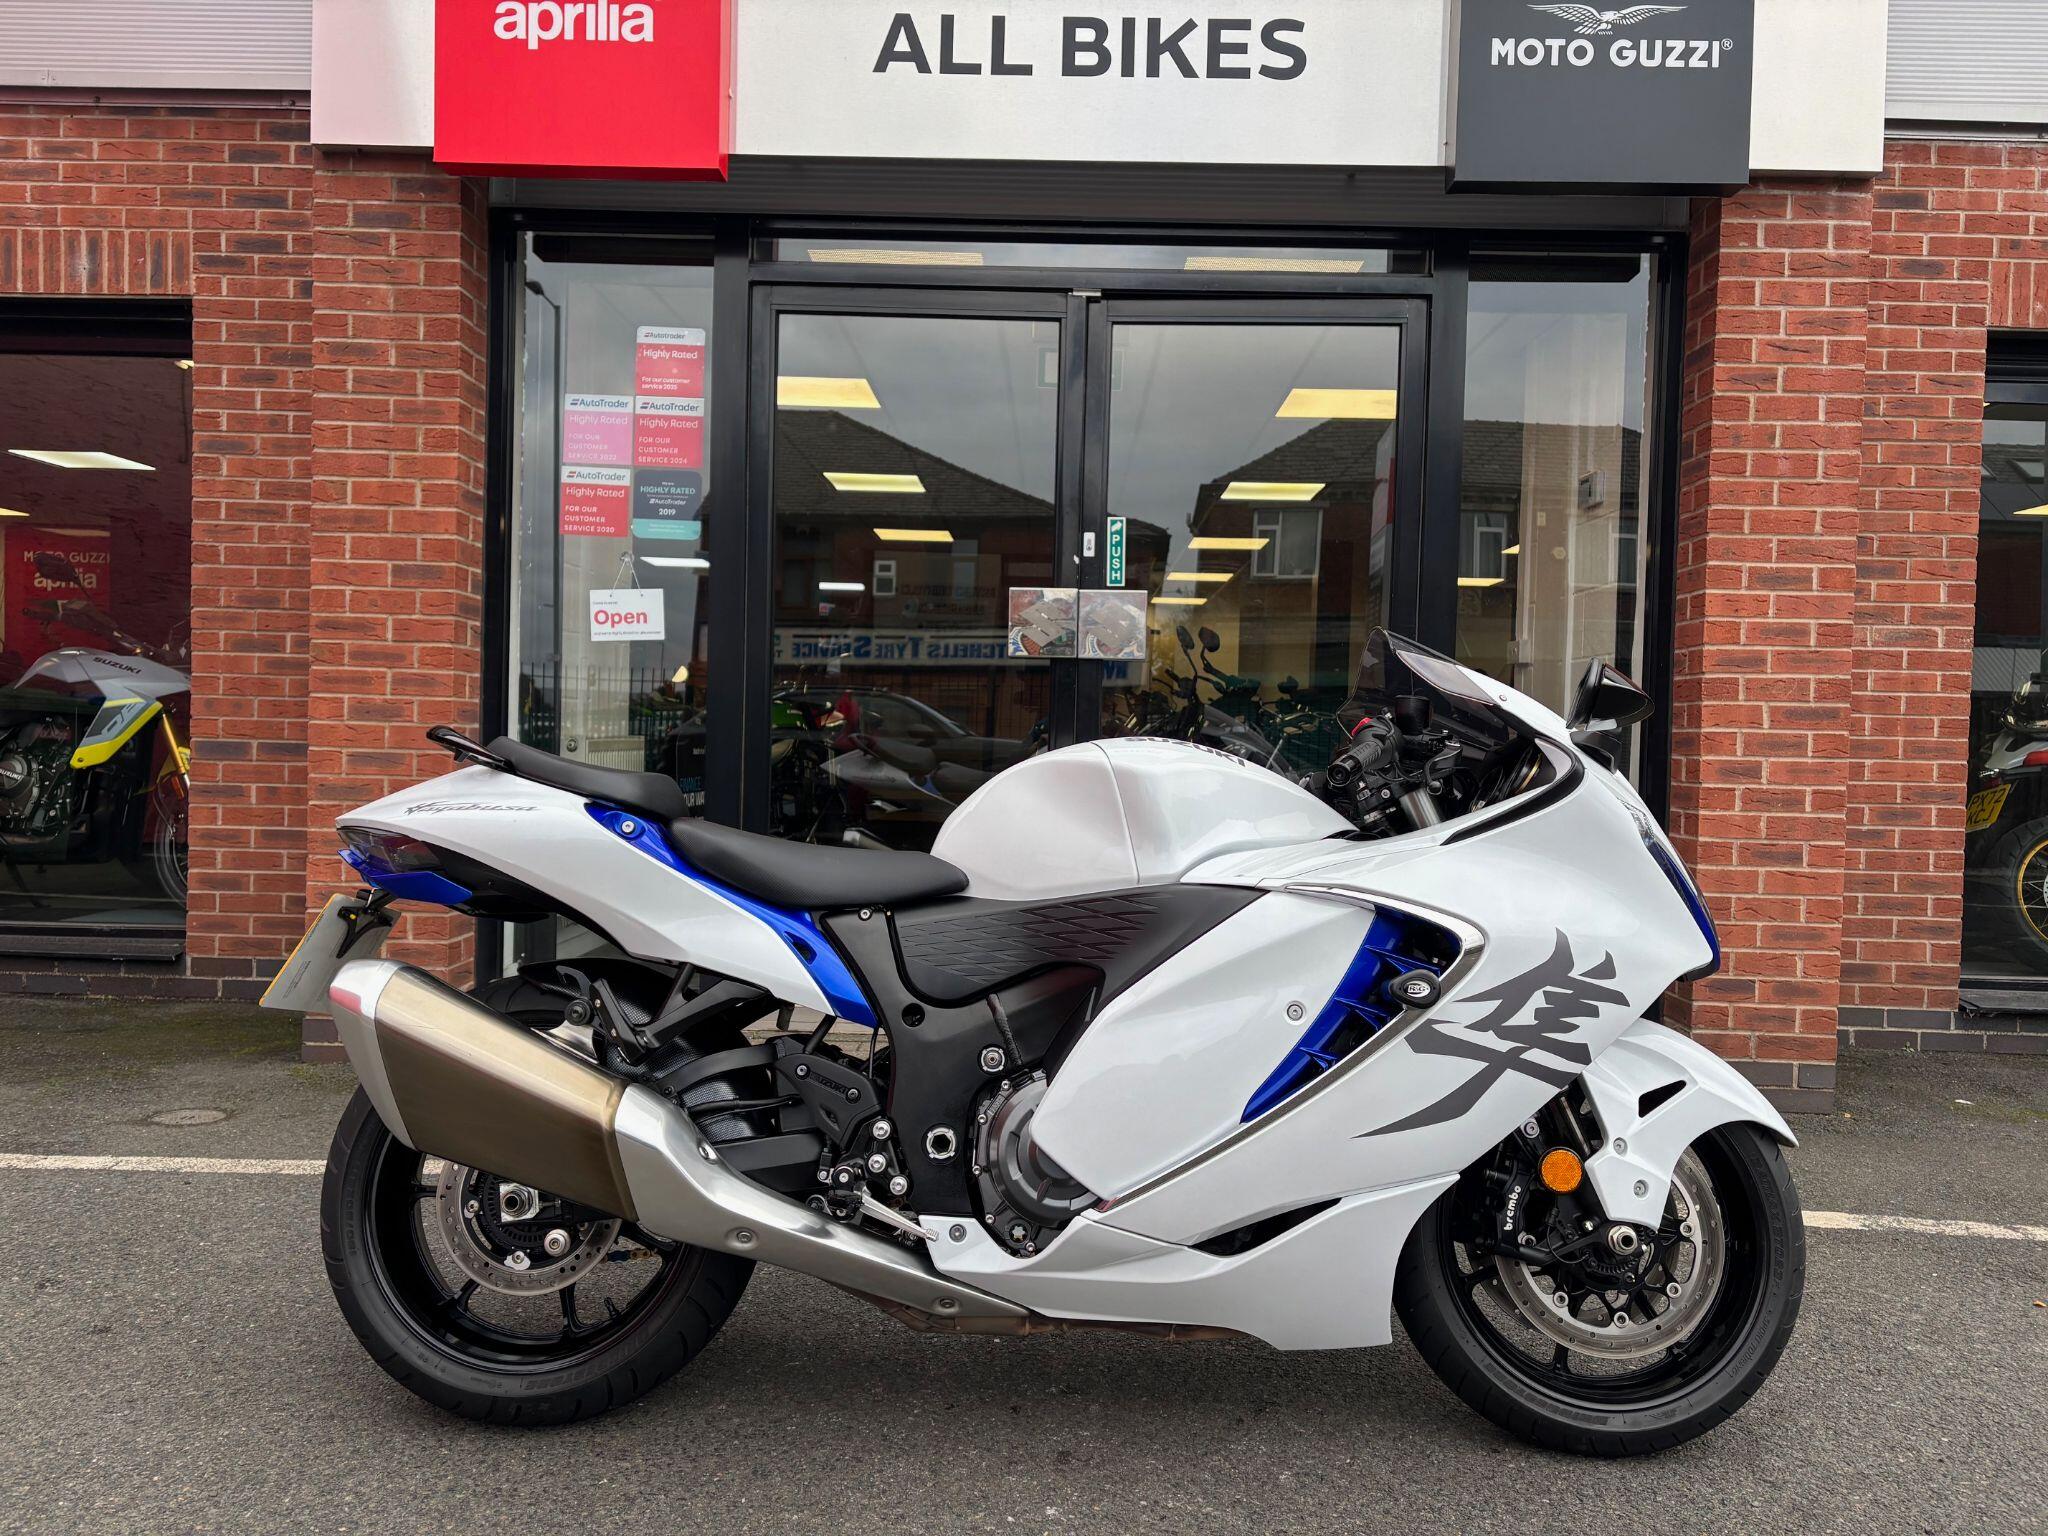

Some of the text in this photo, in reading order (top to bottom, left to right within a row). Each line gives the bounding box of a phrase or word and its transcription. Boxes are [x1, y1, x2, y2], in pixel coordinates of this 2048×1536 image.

[493, 0, 655, 50] aprilia
[872, 12, 1307, 81] ALL BIKES
[1491, 37, 1595, 67] MOTO
[643, 349, 698, 360] Highly Rated
[579, 399, 629, 408] AutoTrader
[648, 402, 699, 412] AutoTrader
[569, 415, 628, 425] Highly Rated
[639, 417, 698, 428] Highly Rated
[638, 446, 679, 454] CUSTOMER
[575, 471, 626, 481] AutoTrader
[566, 486, 625, 498] Highly Rated
[640, 486, 696, 495] HIGHLY RATED
[658, 508, 676, 516] 2019
[564, 515, 606, 523] CUSTOMER
[69, 552, 111, 563] GUZZI
[1112, 534, 1121, 581] PUSH
[593, 609, 648, 628] Open
[92, 656, 143, 675] SUZUKI
[403, 801, 542, 816] Hayabusa
[1503, 1185, 1522, 1231] brembo
